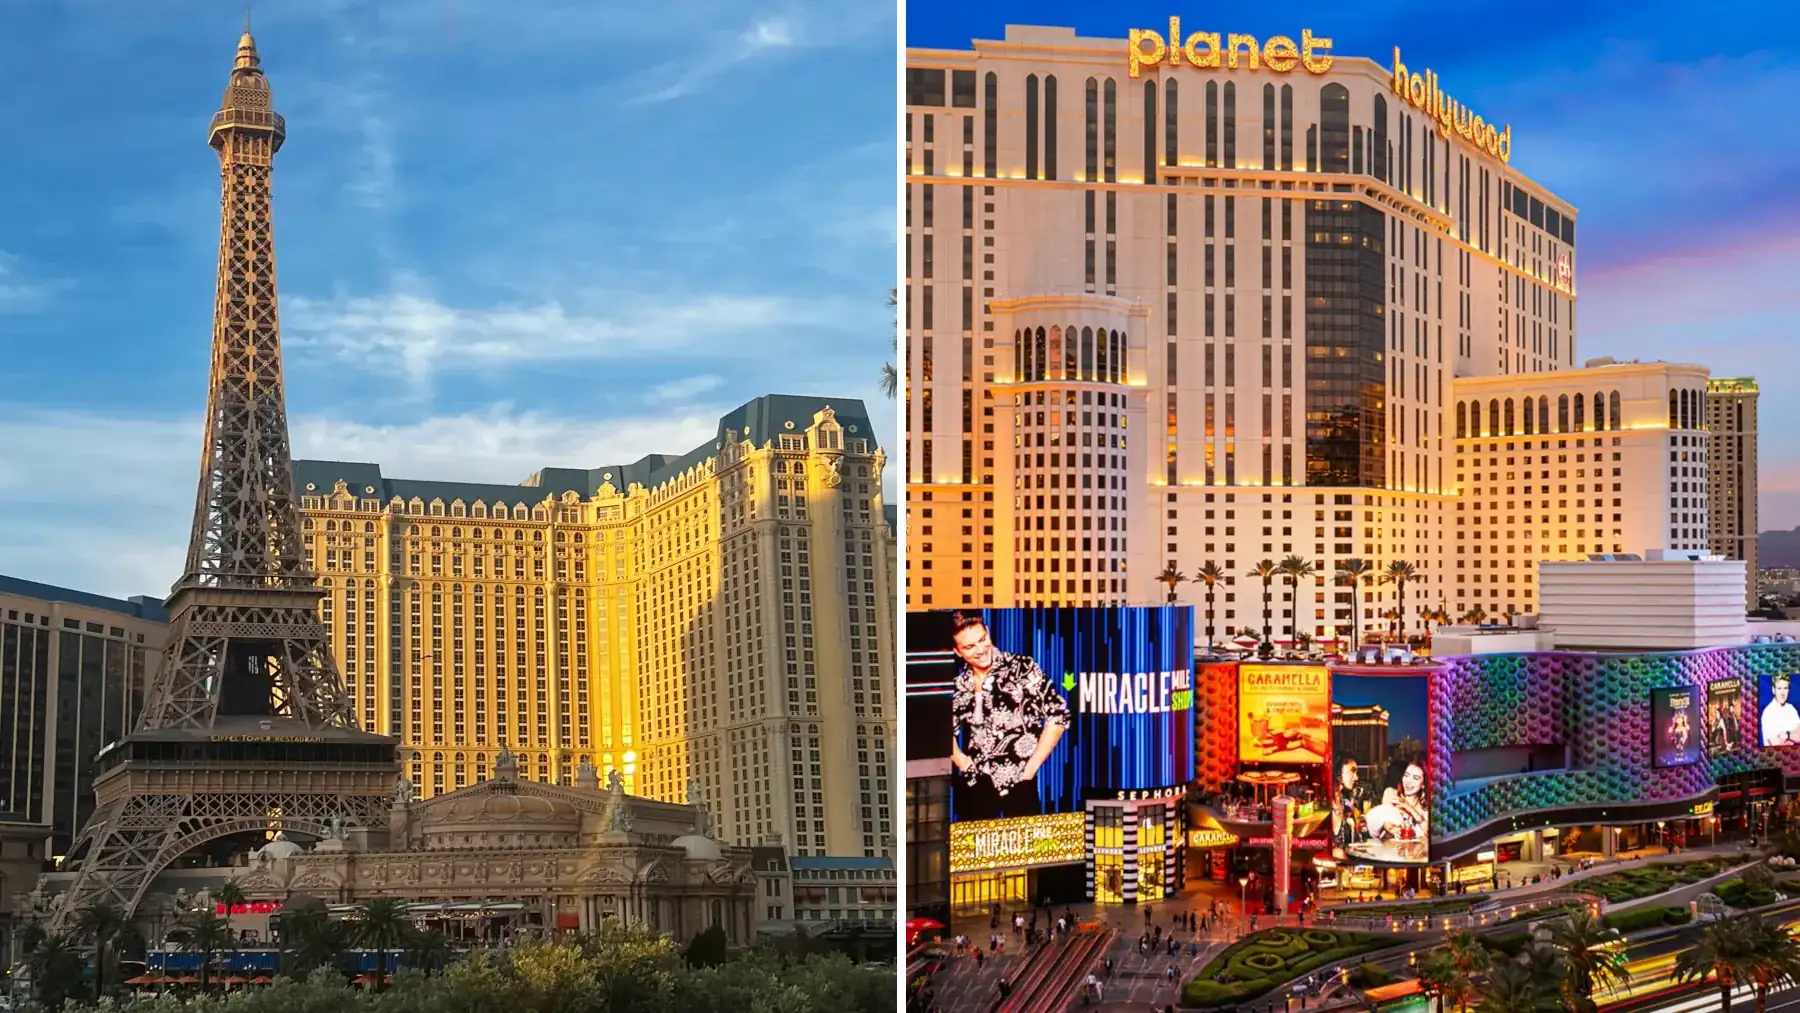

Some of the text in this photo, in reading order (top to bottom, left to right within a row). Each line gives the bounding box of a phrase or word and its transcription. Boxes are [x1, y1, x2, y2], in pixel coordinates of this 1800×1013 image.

[1128, 15, 1334, 78] planet
[1393, 45, 1511, 164] hollywood
[1080, 669, 1190, 714] MIRACLE MILE
[1247, 673, 1321, 686] CARAMELLA
[242, 734, 271, 743] TOWER
[275, 735, 325, 744] RESTAURANT
[1118, 784, 1187, 801] SEPHORA
[975, 827, 1034, 858] MIRACLE
